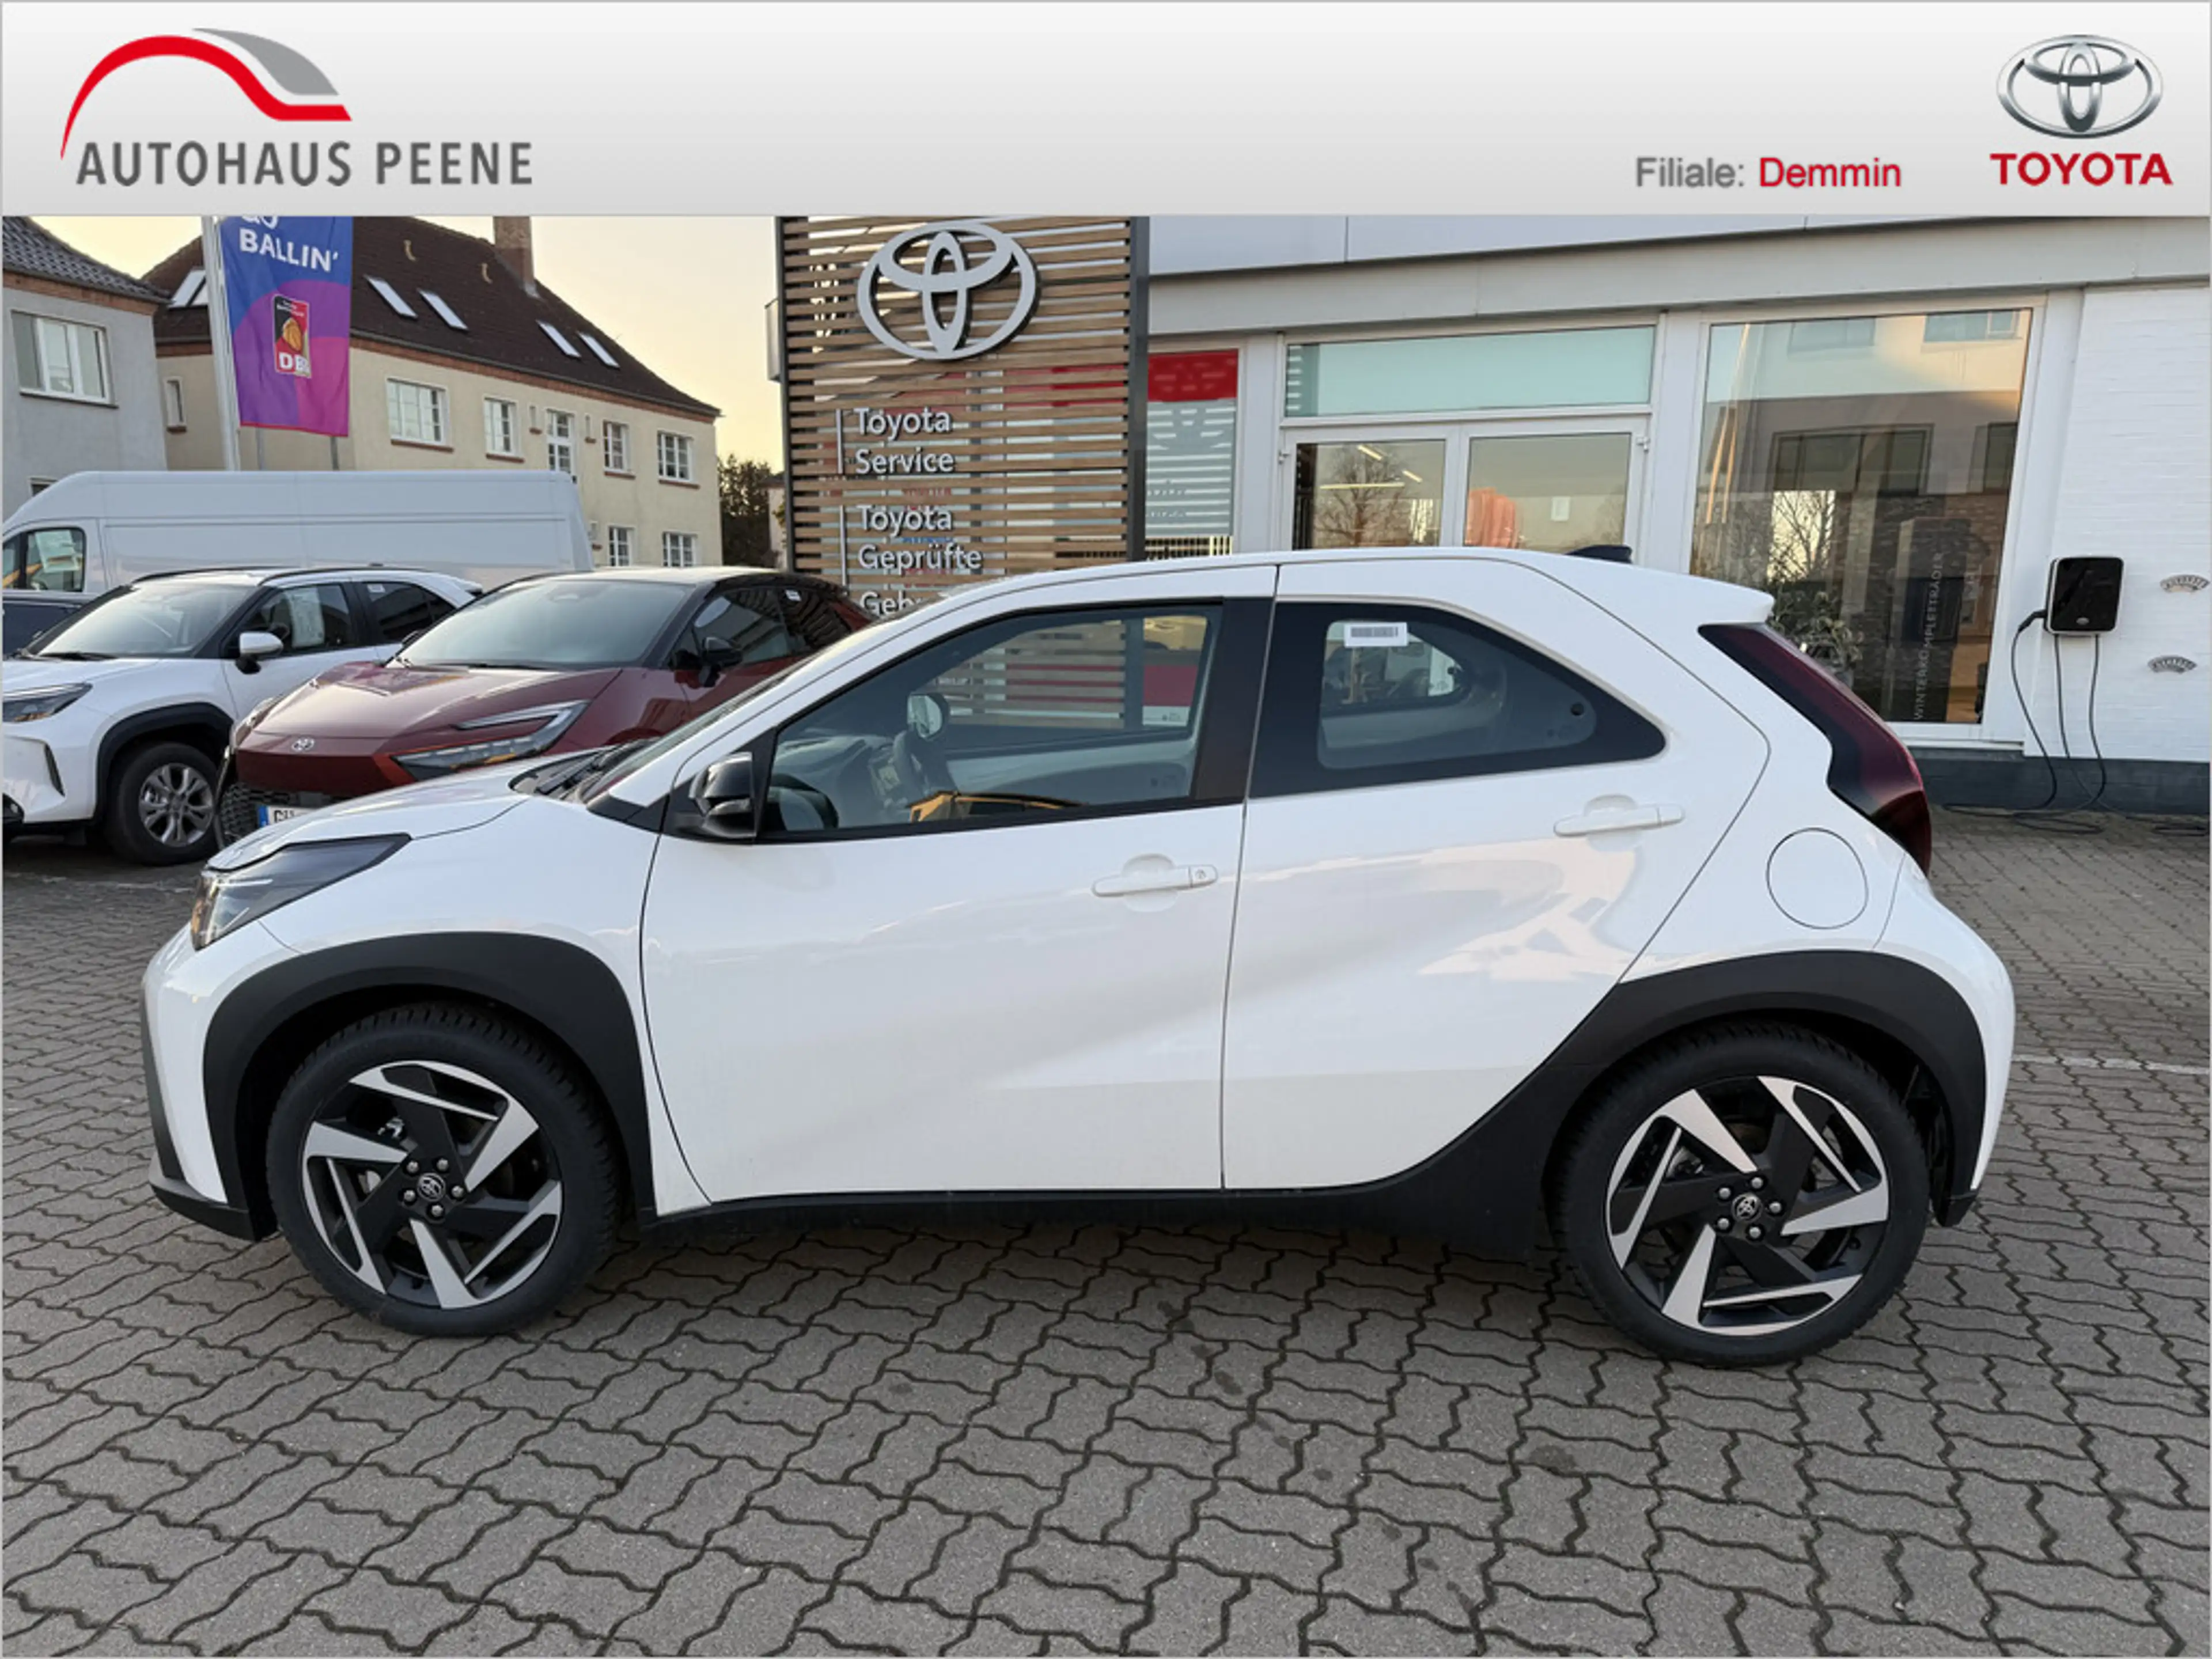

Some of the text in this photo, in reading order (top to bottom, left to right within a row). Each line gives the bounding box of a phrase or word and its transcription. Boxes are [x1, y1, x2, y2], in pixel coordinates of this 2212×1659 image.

[239, 228, 339, 272] BALLIN'
[853, 407, 952, 440] Toyota
[855, 448, 955, 474] Service
[857, 505, 954, 537] Toyota
[858, 543, 983, 575] Geprüfte
